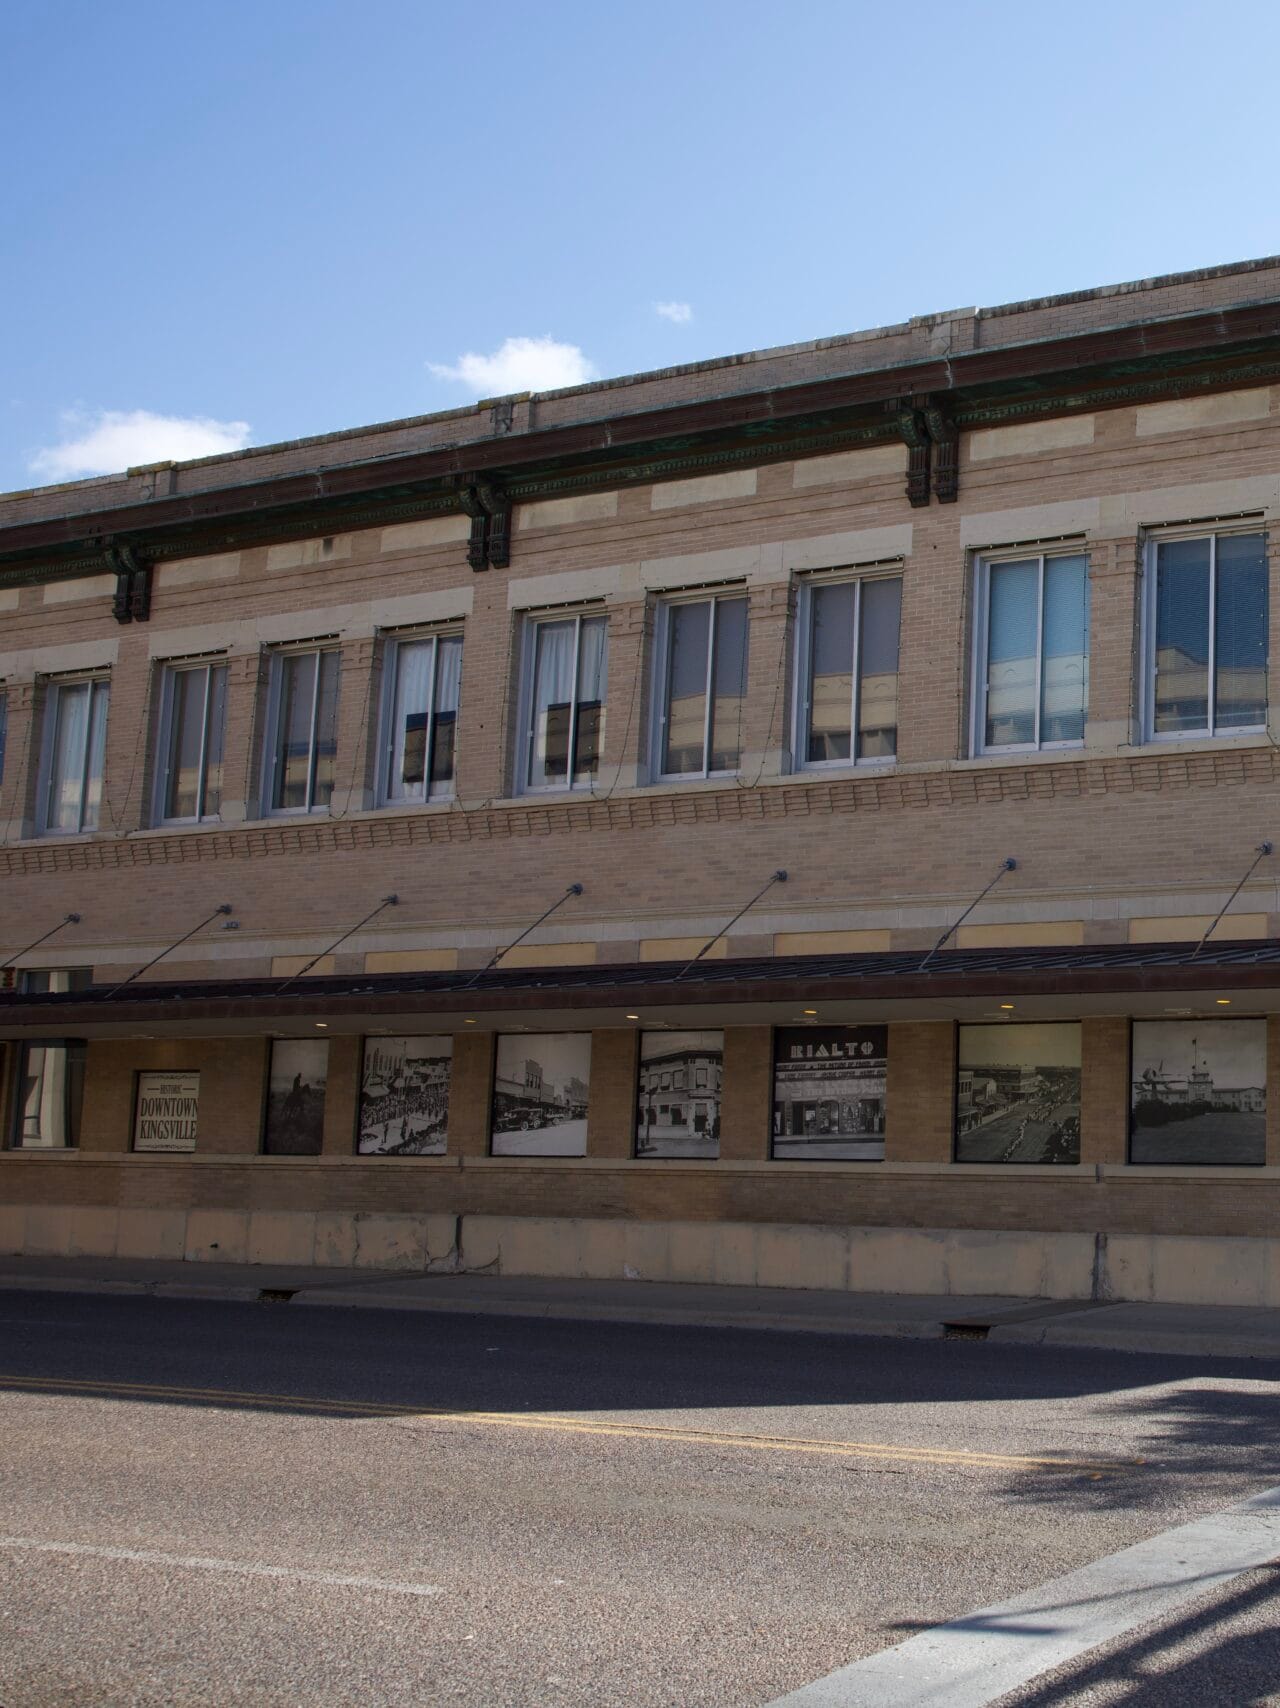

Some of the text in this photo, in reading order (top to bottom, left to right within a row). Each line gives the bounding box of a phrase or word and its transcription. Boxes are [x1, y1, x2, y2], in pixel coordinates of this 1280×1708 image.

[791, 1041, 874, 1058] RIALTO
[140, 1098, 199, 1117] DOWNTOWN
[140, 1120, 197, 1139] KINGSVILLE
